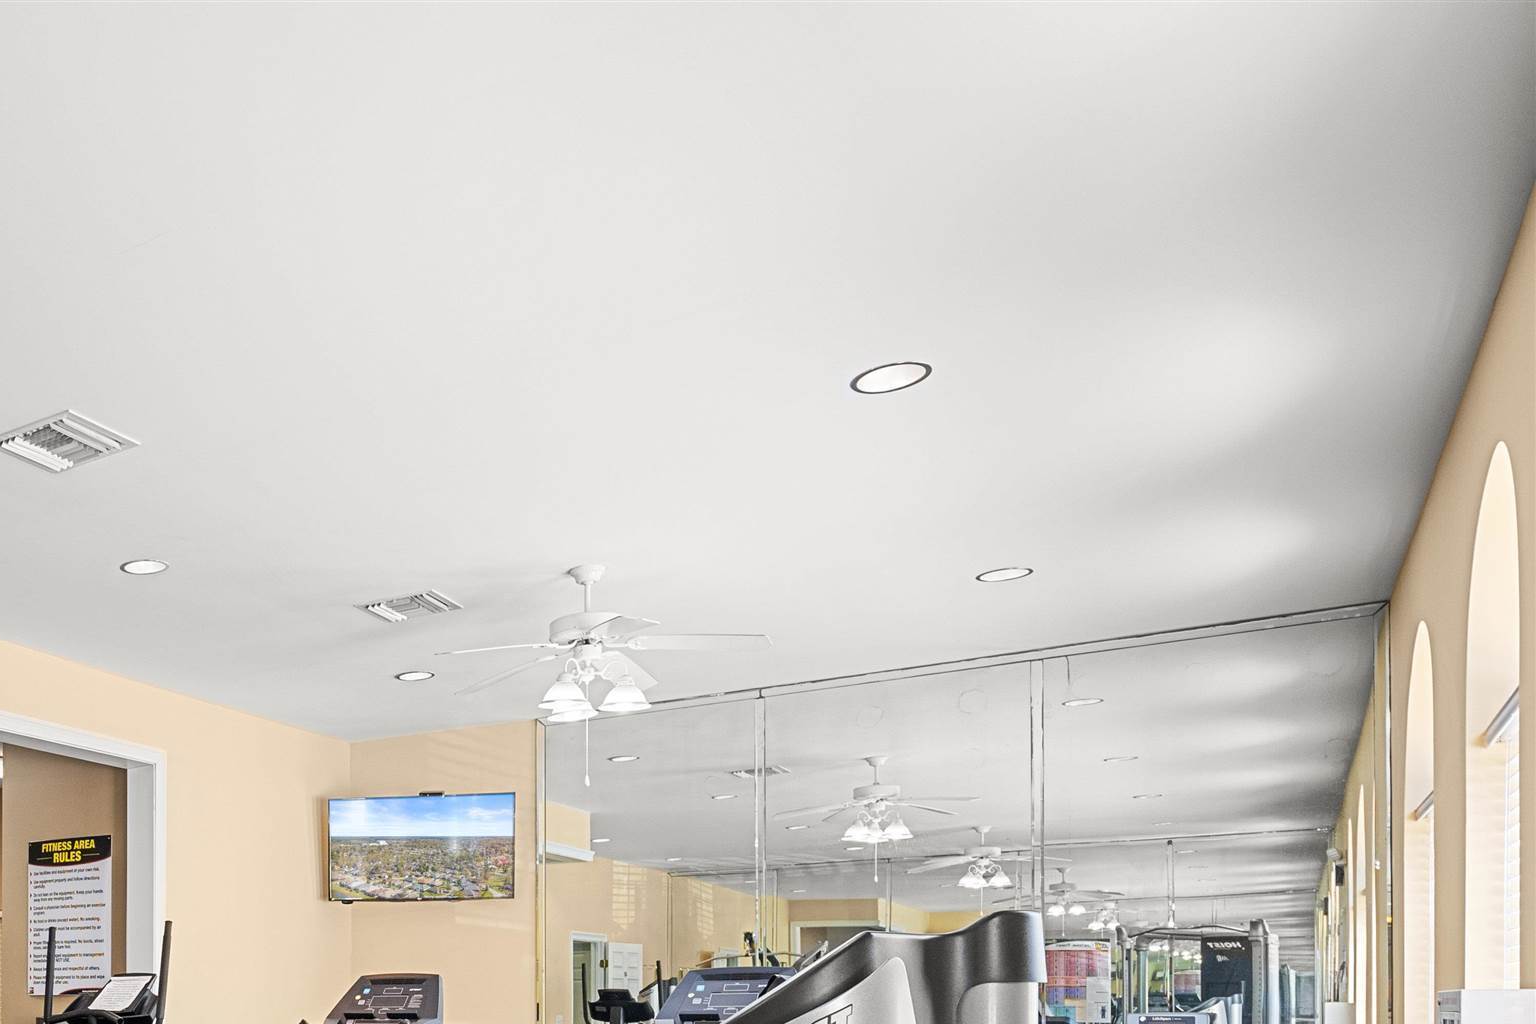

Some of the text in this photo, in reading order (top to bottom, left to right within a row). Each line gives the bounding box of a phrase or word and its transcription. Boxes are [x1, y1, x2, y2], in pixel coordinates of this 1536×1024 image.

[42, 839, 95, 853] FITNESS AREA
[53, 851, 82, 863] RULES
